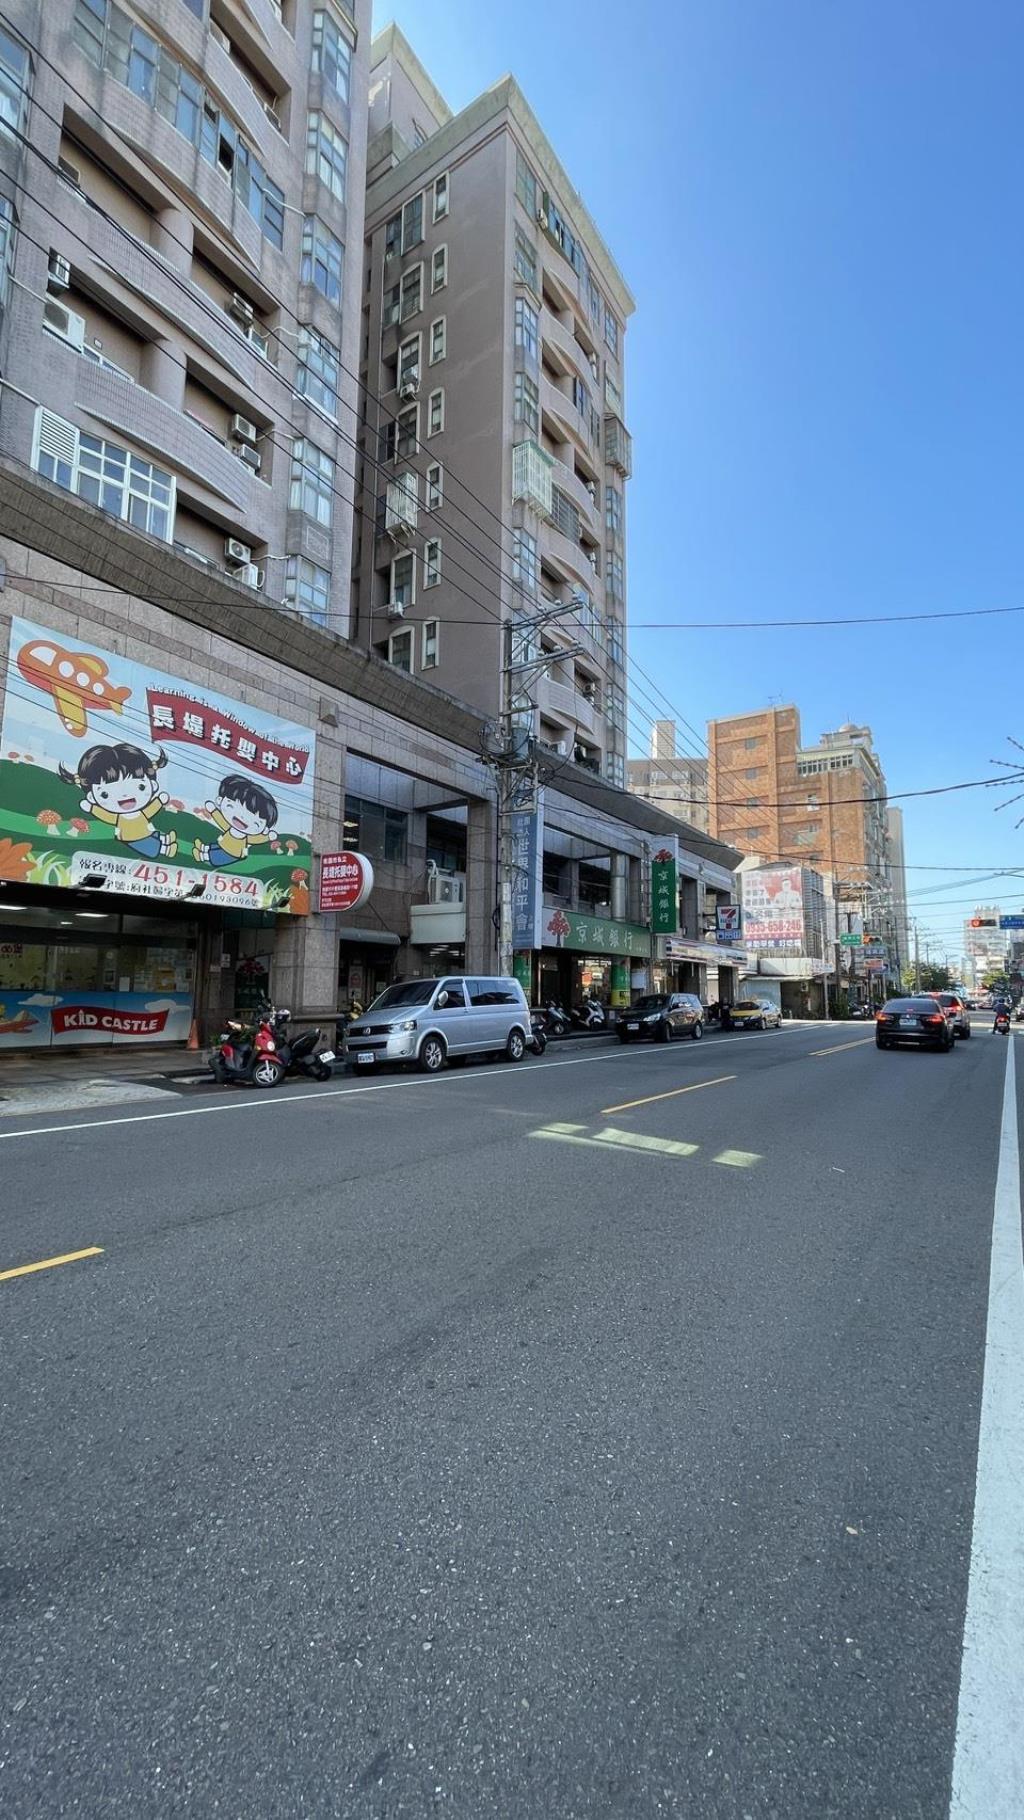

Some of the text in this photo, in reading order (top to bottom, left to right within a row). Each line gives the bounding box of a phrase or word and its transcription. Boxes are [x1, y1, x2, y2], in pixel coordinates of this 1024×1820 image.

[152, 704, 303, 777] 長堤托嬰中心
[133, 863, 258, 896] 451-1584
[575, 921, 633, 950] 京城銀行
[64, 1009, 158, 1031] KID CASTLE
